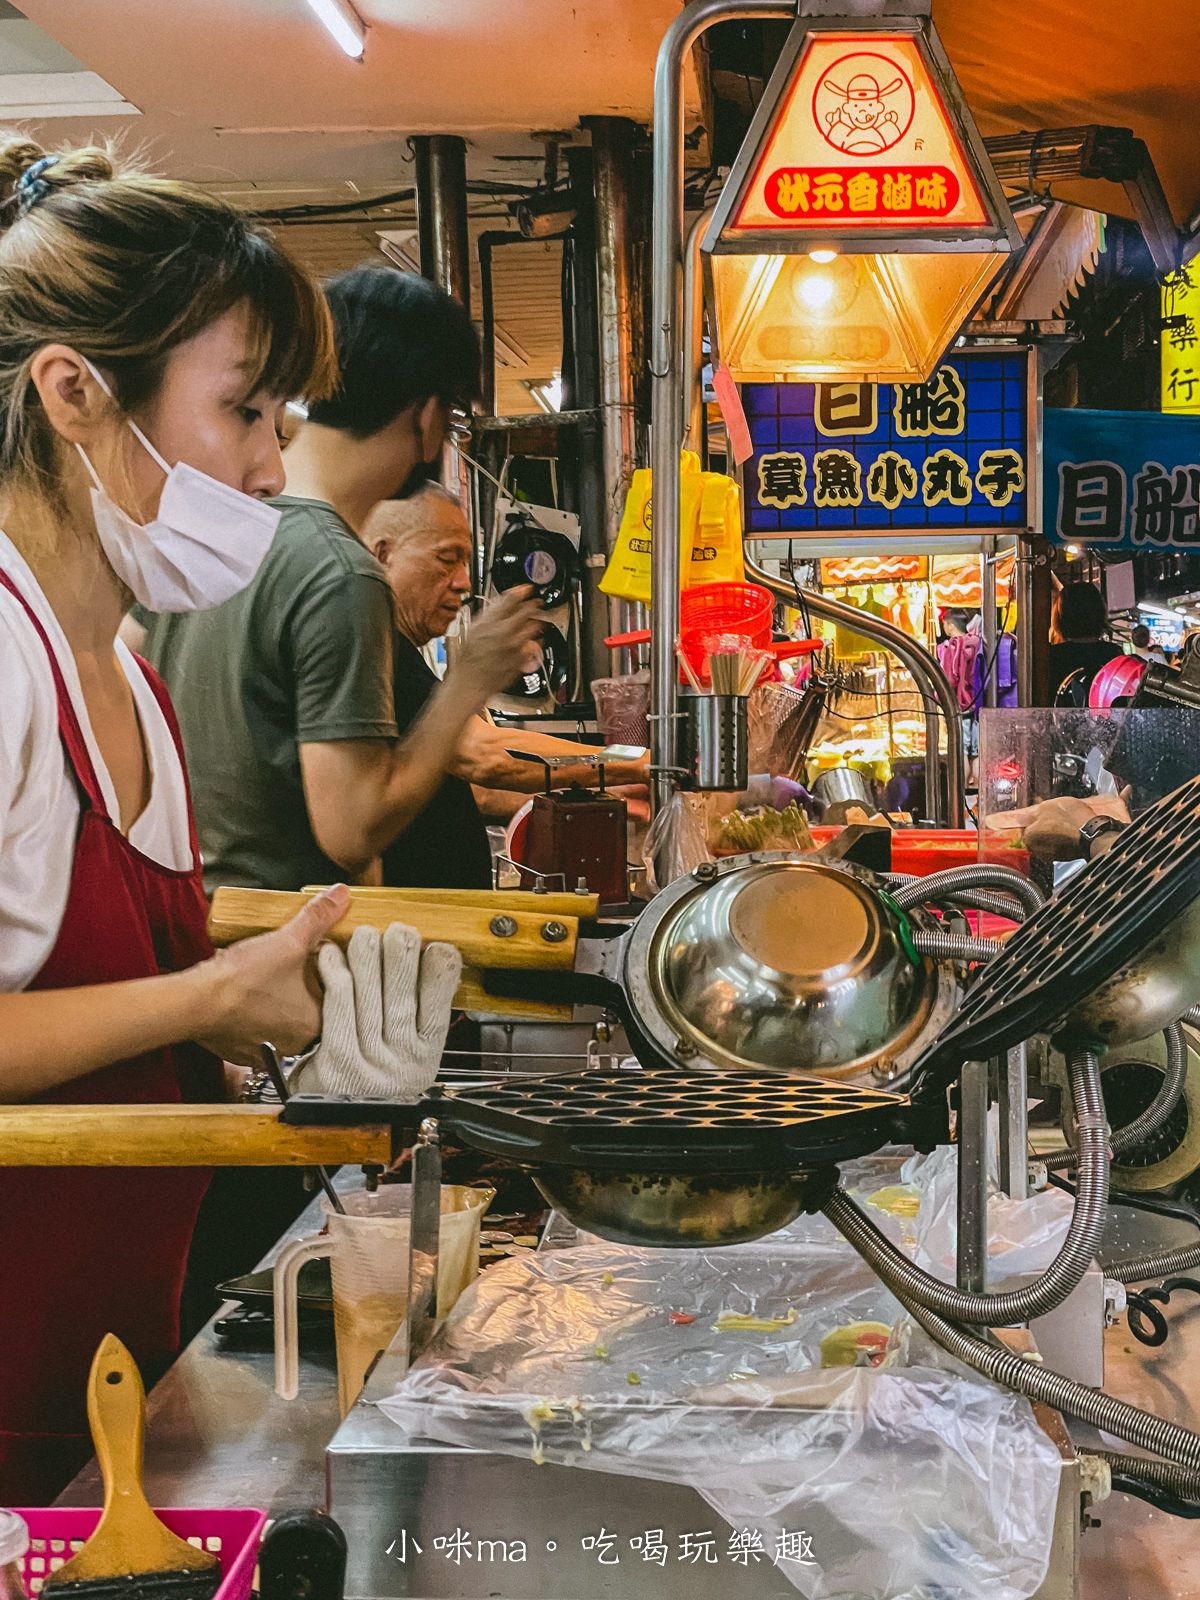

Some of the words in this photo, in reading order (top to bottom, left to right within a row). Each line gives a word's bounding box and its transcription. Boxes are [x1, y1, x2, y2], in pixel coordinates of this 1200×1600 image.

[757, 449, 1025, 510] 章魚小丸子
[1056, 460, 1200, 547] 日船
